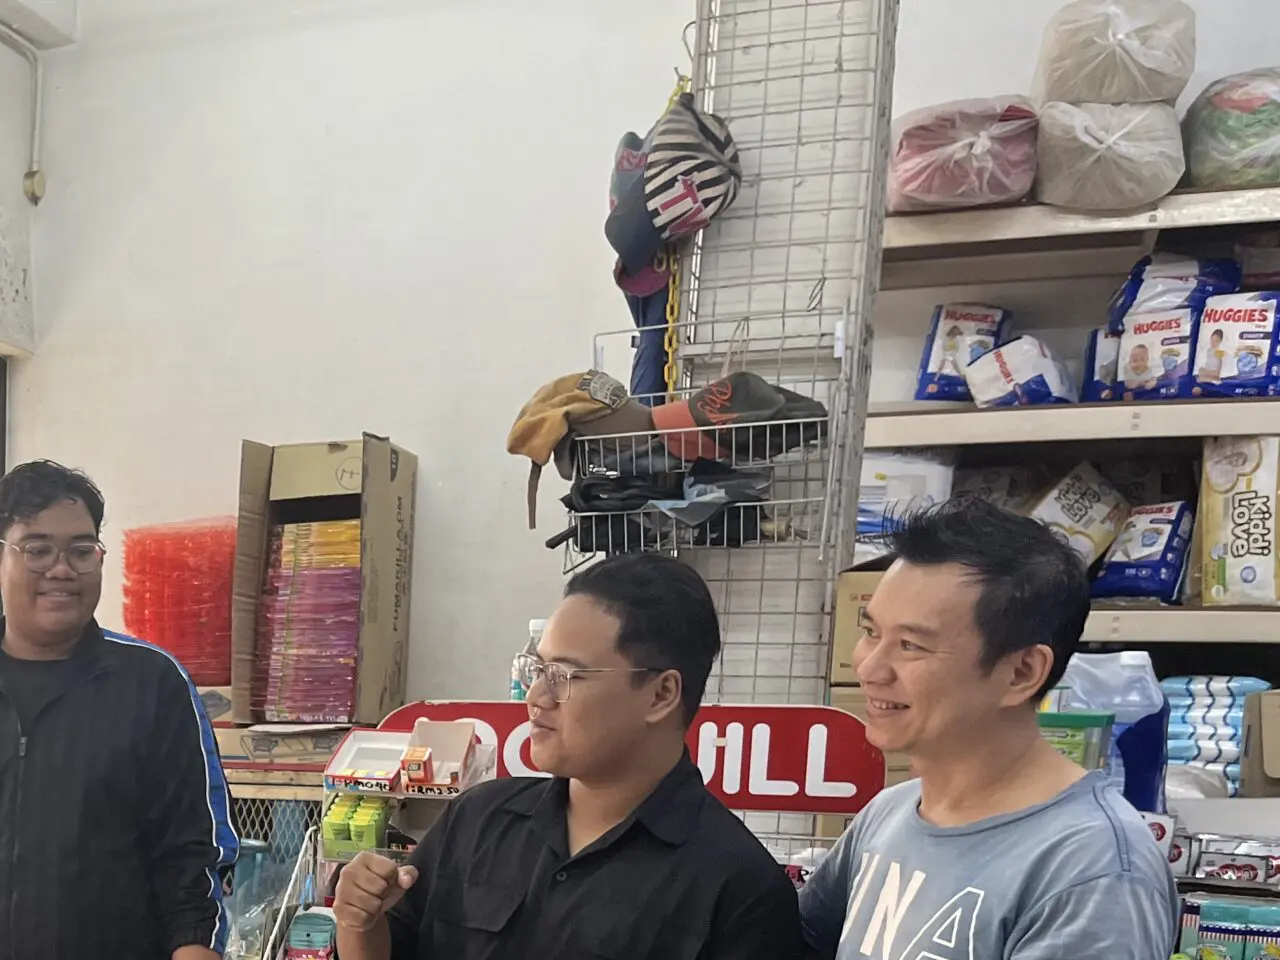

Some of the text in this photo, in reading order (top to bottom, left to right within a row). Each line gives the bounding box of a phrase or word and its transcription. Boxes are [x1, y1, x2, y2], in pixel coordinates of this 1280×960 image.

[943, 309, 997, 325] HUGGIES
[1202, 308, 1268, 323] HUGGIES
[1133, 318, 1181, 335] HUGGIES
[1231, 490, 1258, 558] Love
[1249, 495, 1273, 558] Kiddi
